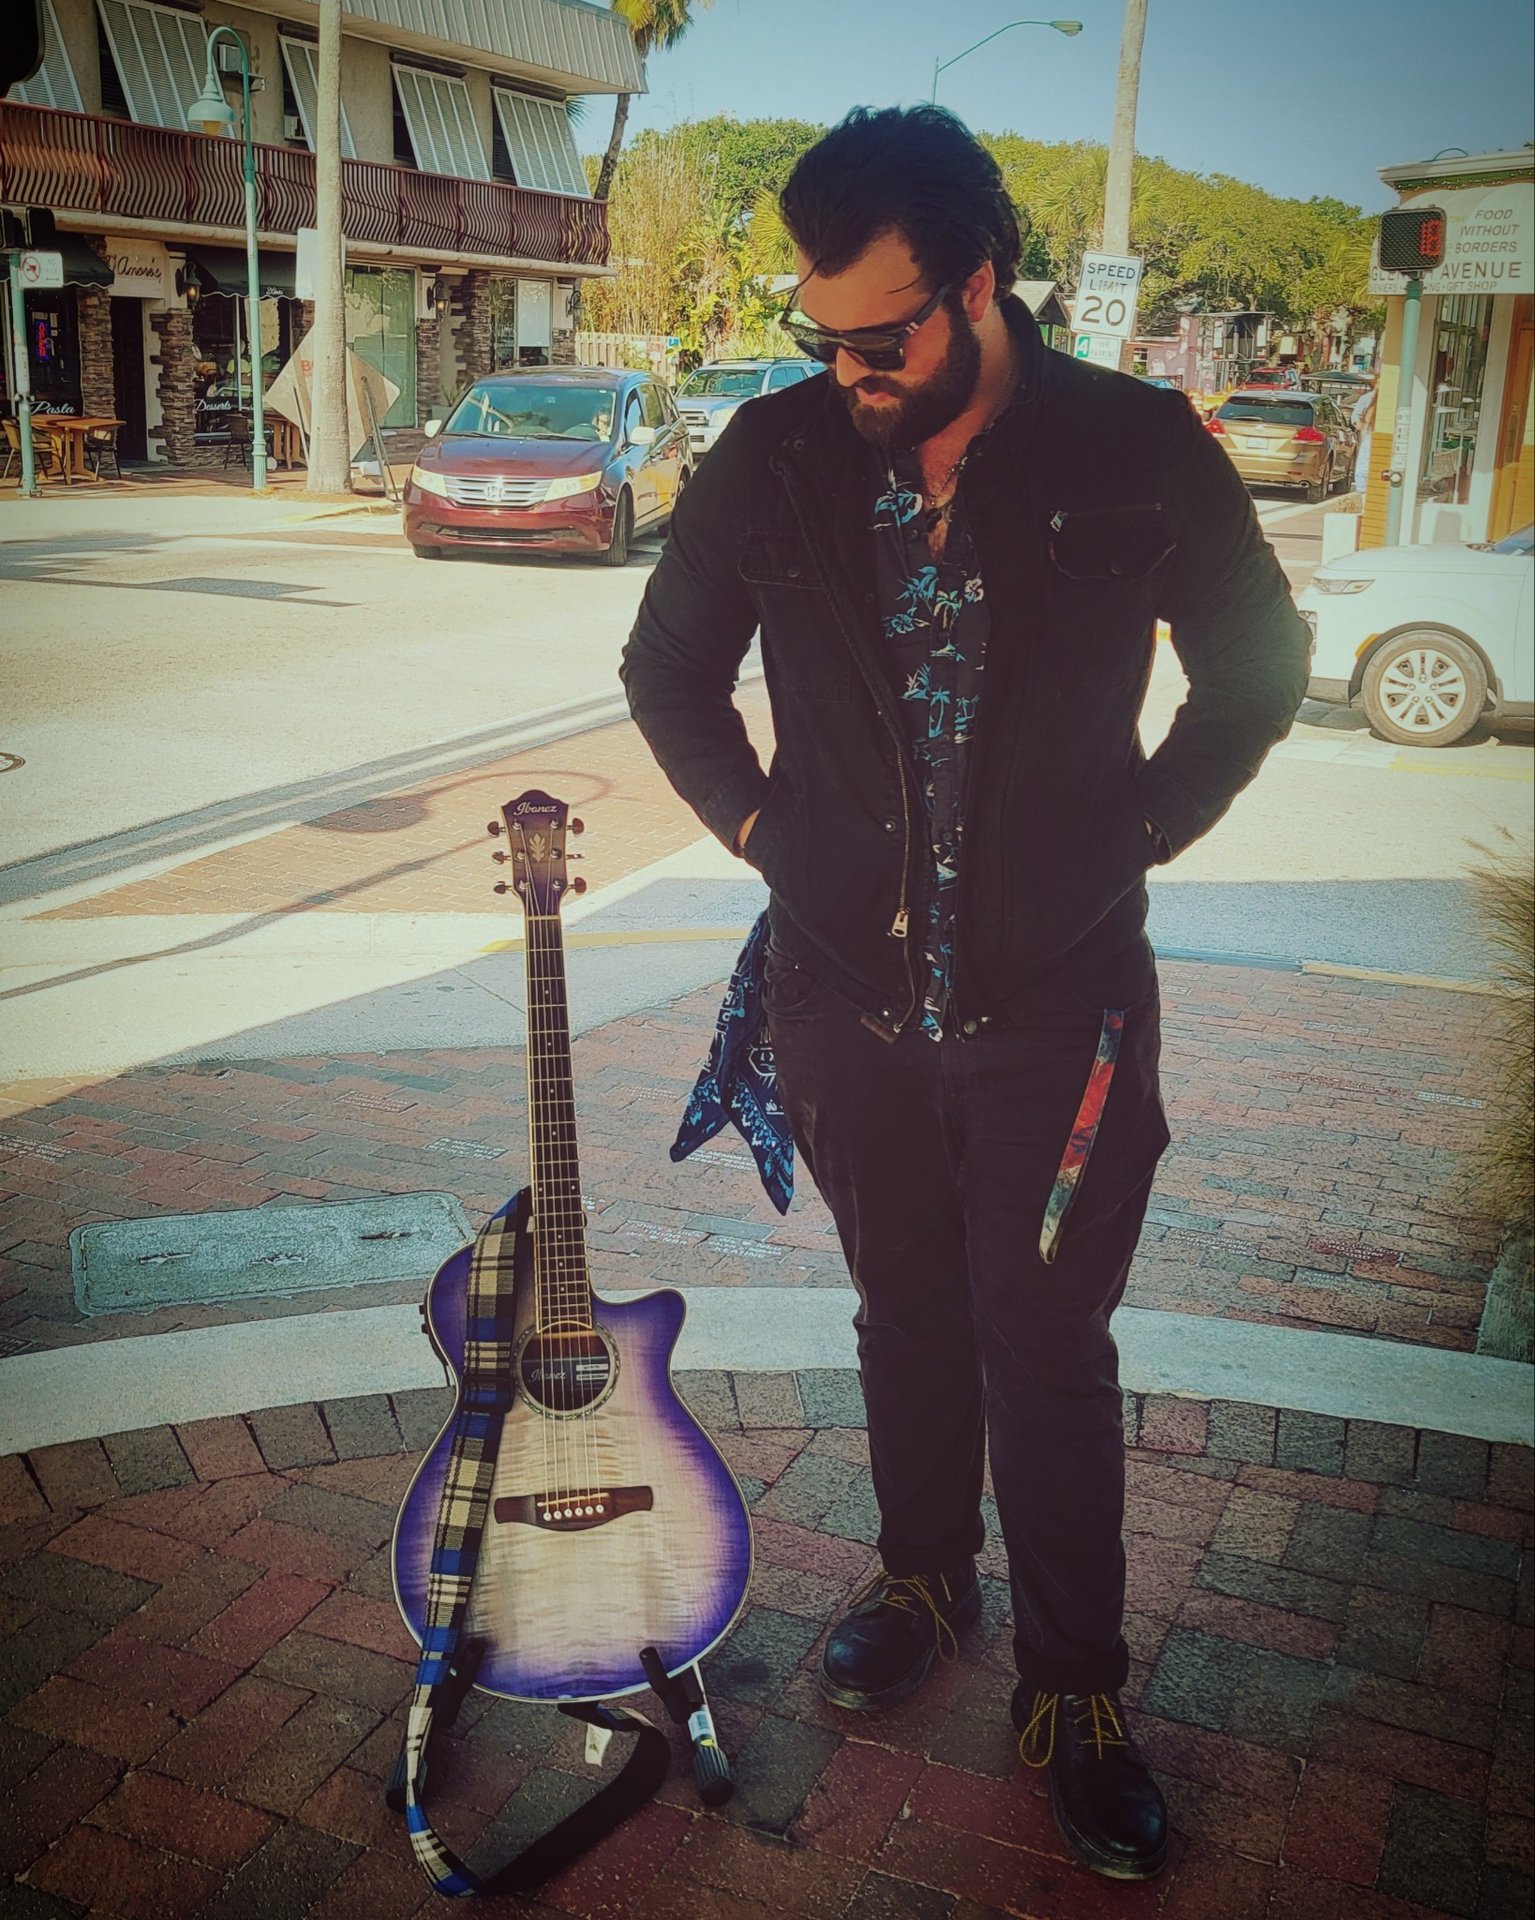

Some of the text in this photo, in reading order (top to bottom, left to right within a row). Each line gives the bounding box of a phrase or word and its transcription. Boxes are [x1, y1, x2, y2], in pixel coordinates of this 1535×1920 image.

[1474, 208, 1514, 220] FOOD
[1458, 223, 1521, 236] WITHOUT
[1455, 241, 1518, 254] BORDERS
[1086, 262, 1136, 279] SPEED
[1440, 261, 1523, 280] AVENUE
[1088, 279, 1128, 294] LIMIT
[1447, 281, 1466, 292] GIFT
[1467, 280, 1498, 292] SHOP
[1081, 295, 1126, 327] 20
[29, 400, 76, 415] Pasta
[193, 398, 232, 411] Desserts
[513, 802, 558, 816] Ibanez
